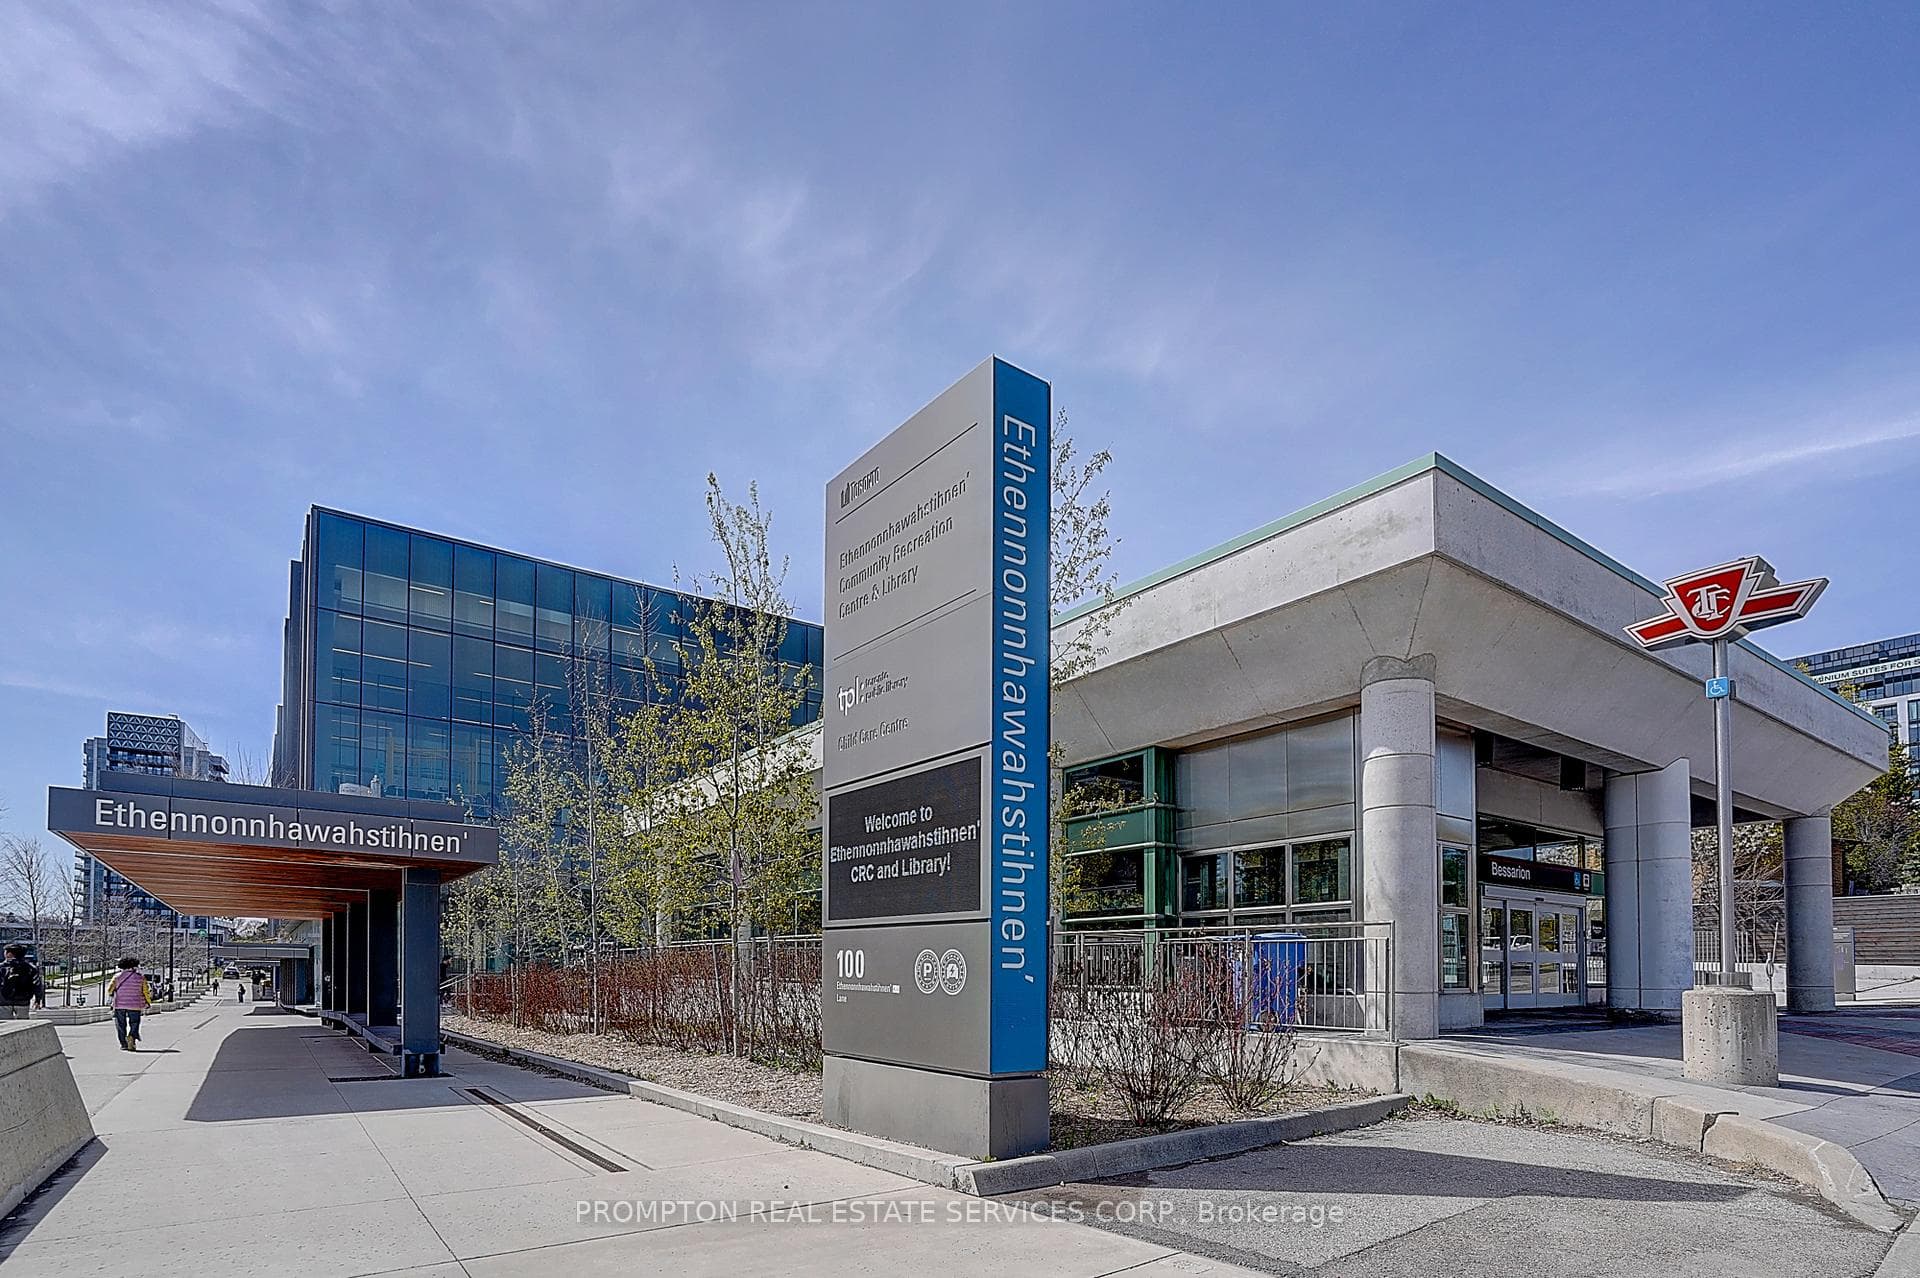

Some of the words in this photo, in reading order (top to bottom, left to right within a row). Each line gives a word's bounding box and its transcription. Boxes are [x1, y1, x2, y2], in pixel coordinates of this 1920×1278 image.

[839, 471, 970, 571] Ethennonnhawahstihnen'
[839, 554, 891, 594] Community
[893, 516, 953, 563] Recreation
[839, 592, 869, 619] Centre
[871, 583, 880, 601] &
[882, 565, 918, 596] Library
[1686, 583, 1731, 621] TTC
[1851, 664, 1888, 677] SUITES
[1890, 660, 1911, 670] FOR
[1001, 413, 1037, 984] Ethennonnhawahstihnen'
[838, 731, 858, 751] Child
[859, 728, 878, 744] Care
[879, 718, 909, 737] Centre
[95, 798, 469, 853] Ethennonnhawahstihnen'
[864, 809, 917, 833] Welcome
[919, 805, 933, 822] to
[830, 819, 981, 863] Ethennonnhawahstihnen'
[850, 864, 874, 883] CRC
[876, 859, 899, 879] and
[901, 852, 951, 877] Library!
[1491, 861, 1531, 881] Bessarion
[836, 949, 865, 979] 100
[923, 962, 933, 977] P
